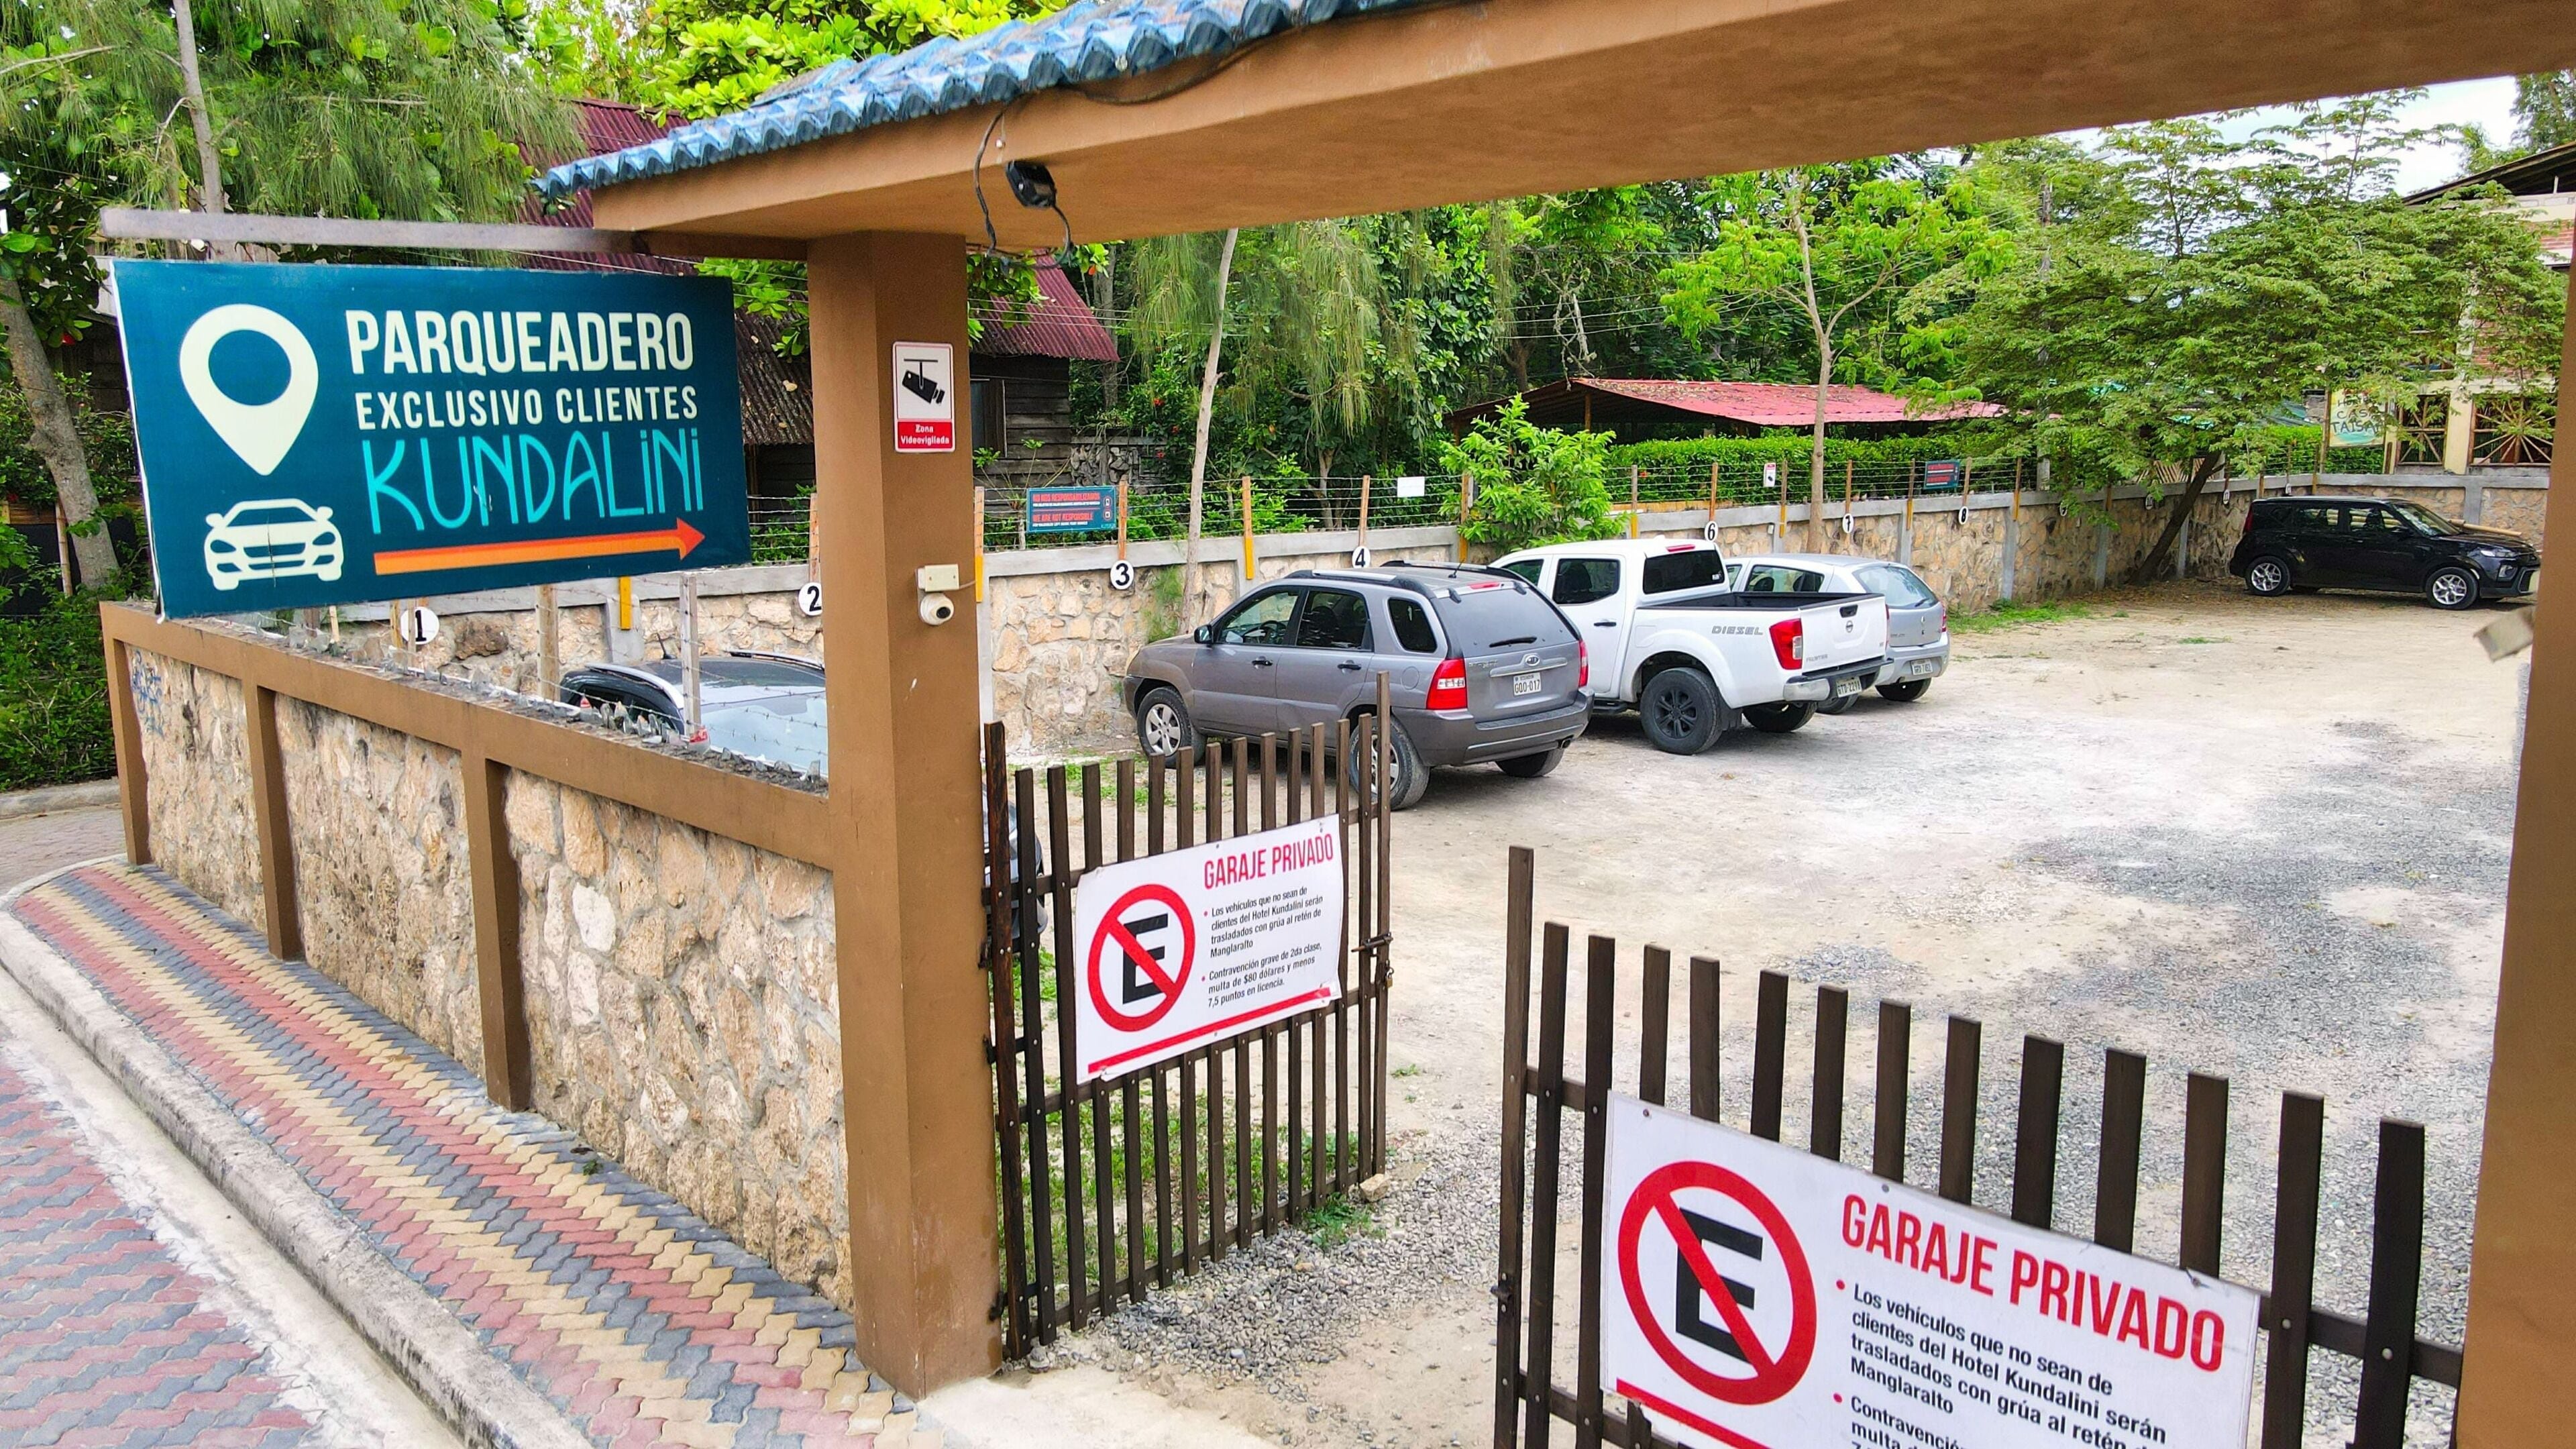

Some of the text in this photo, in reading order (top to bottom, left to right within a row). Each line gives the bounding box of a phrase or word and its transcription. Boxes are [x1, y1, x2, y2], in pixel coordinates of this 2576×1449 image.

[345, 310, 694, 376] PARQUEADERO
[355, 385, 698, 430] EXCLUSIVO CLIENTES
[915, 424, 934, 433] Zona
[1708, 523, 1715, 541] 6
[1845, 515, 1851, 531] 7
[1962, 508, 1966, 523] 8
[1116, 563, 1130, 586] 3
[1355, 548, 1366, 567] 4
[807, 585, 822, 612] 2
[415, 610, 427, 641] 1
[1711, 625, 1764, 635] DIESEL
[1204, 834, 1333, 890] GARAJE PRIVADO
[1212, 908, 1224, 917] Los
[1226, 899, 1257, 913] vehículos
[1258, 896, 1271, 906] que
[1283, 890, 1297, 899] sean
[1299, 886, 1307, 895] de
[1212, 896, 1323, 930] clientes del Hotel Kundalini serán
[1211, 908, 1321, 945] trasladados con grúa al retén de
[1122, 913, 1168, 1004] E
[1209, 942, 1322, 980] Contravención grave de 2da clase,
[1210, 939, 1253, 958] Manglaralto
[1209, 956, 1315, 994] multa de $80 dólares y menos
[1208, 979, 1285, 1008] 7,5 puntos en licencia.
[1676, 1208, 1763, 1365] E
[1841, 1194, 2225, 1373] GARAJE PRIVADO
[1854, 1283, 2112, 1396] Los vehículos que no sean de
[1851, 1333, 1951, 1389] trasladados
[1957, 1380, 1990, 1405] con
[1997, 1395, 2041, 1426] grúa
[2047, 1413, 2065, 1435] al
[1851, 1356, 1953, 1414] Manglaralto
[1852, 1311, 2166, 1445] clientes del Hotel Kundalini serán
